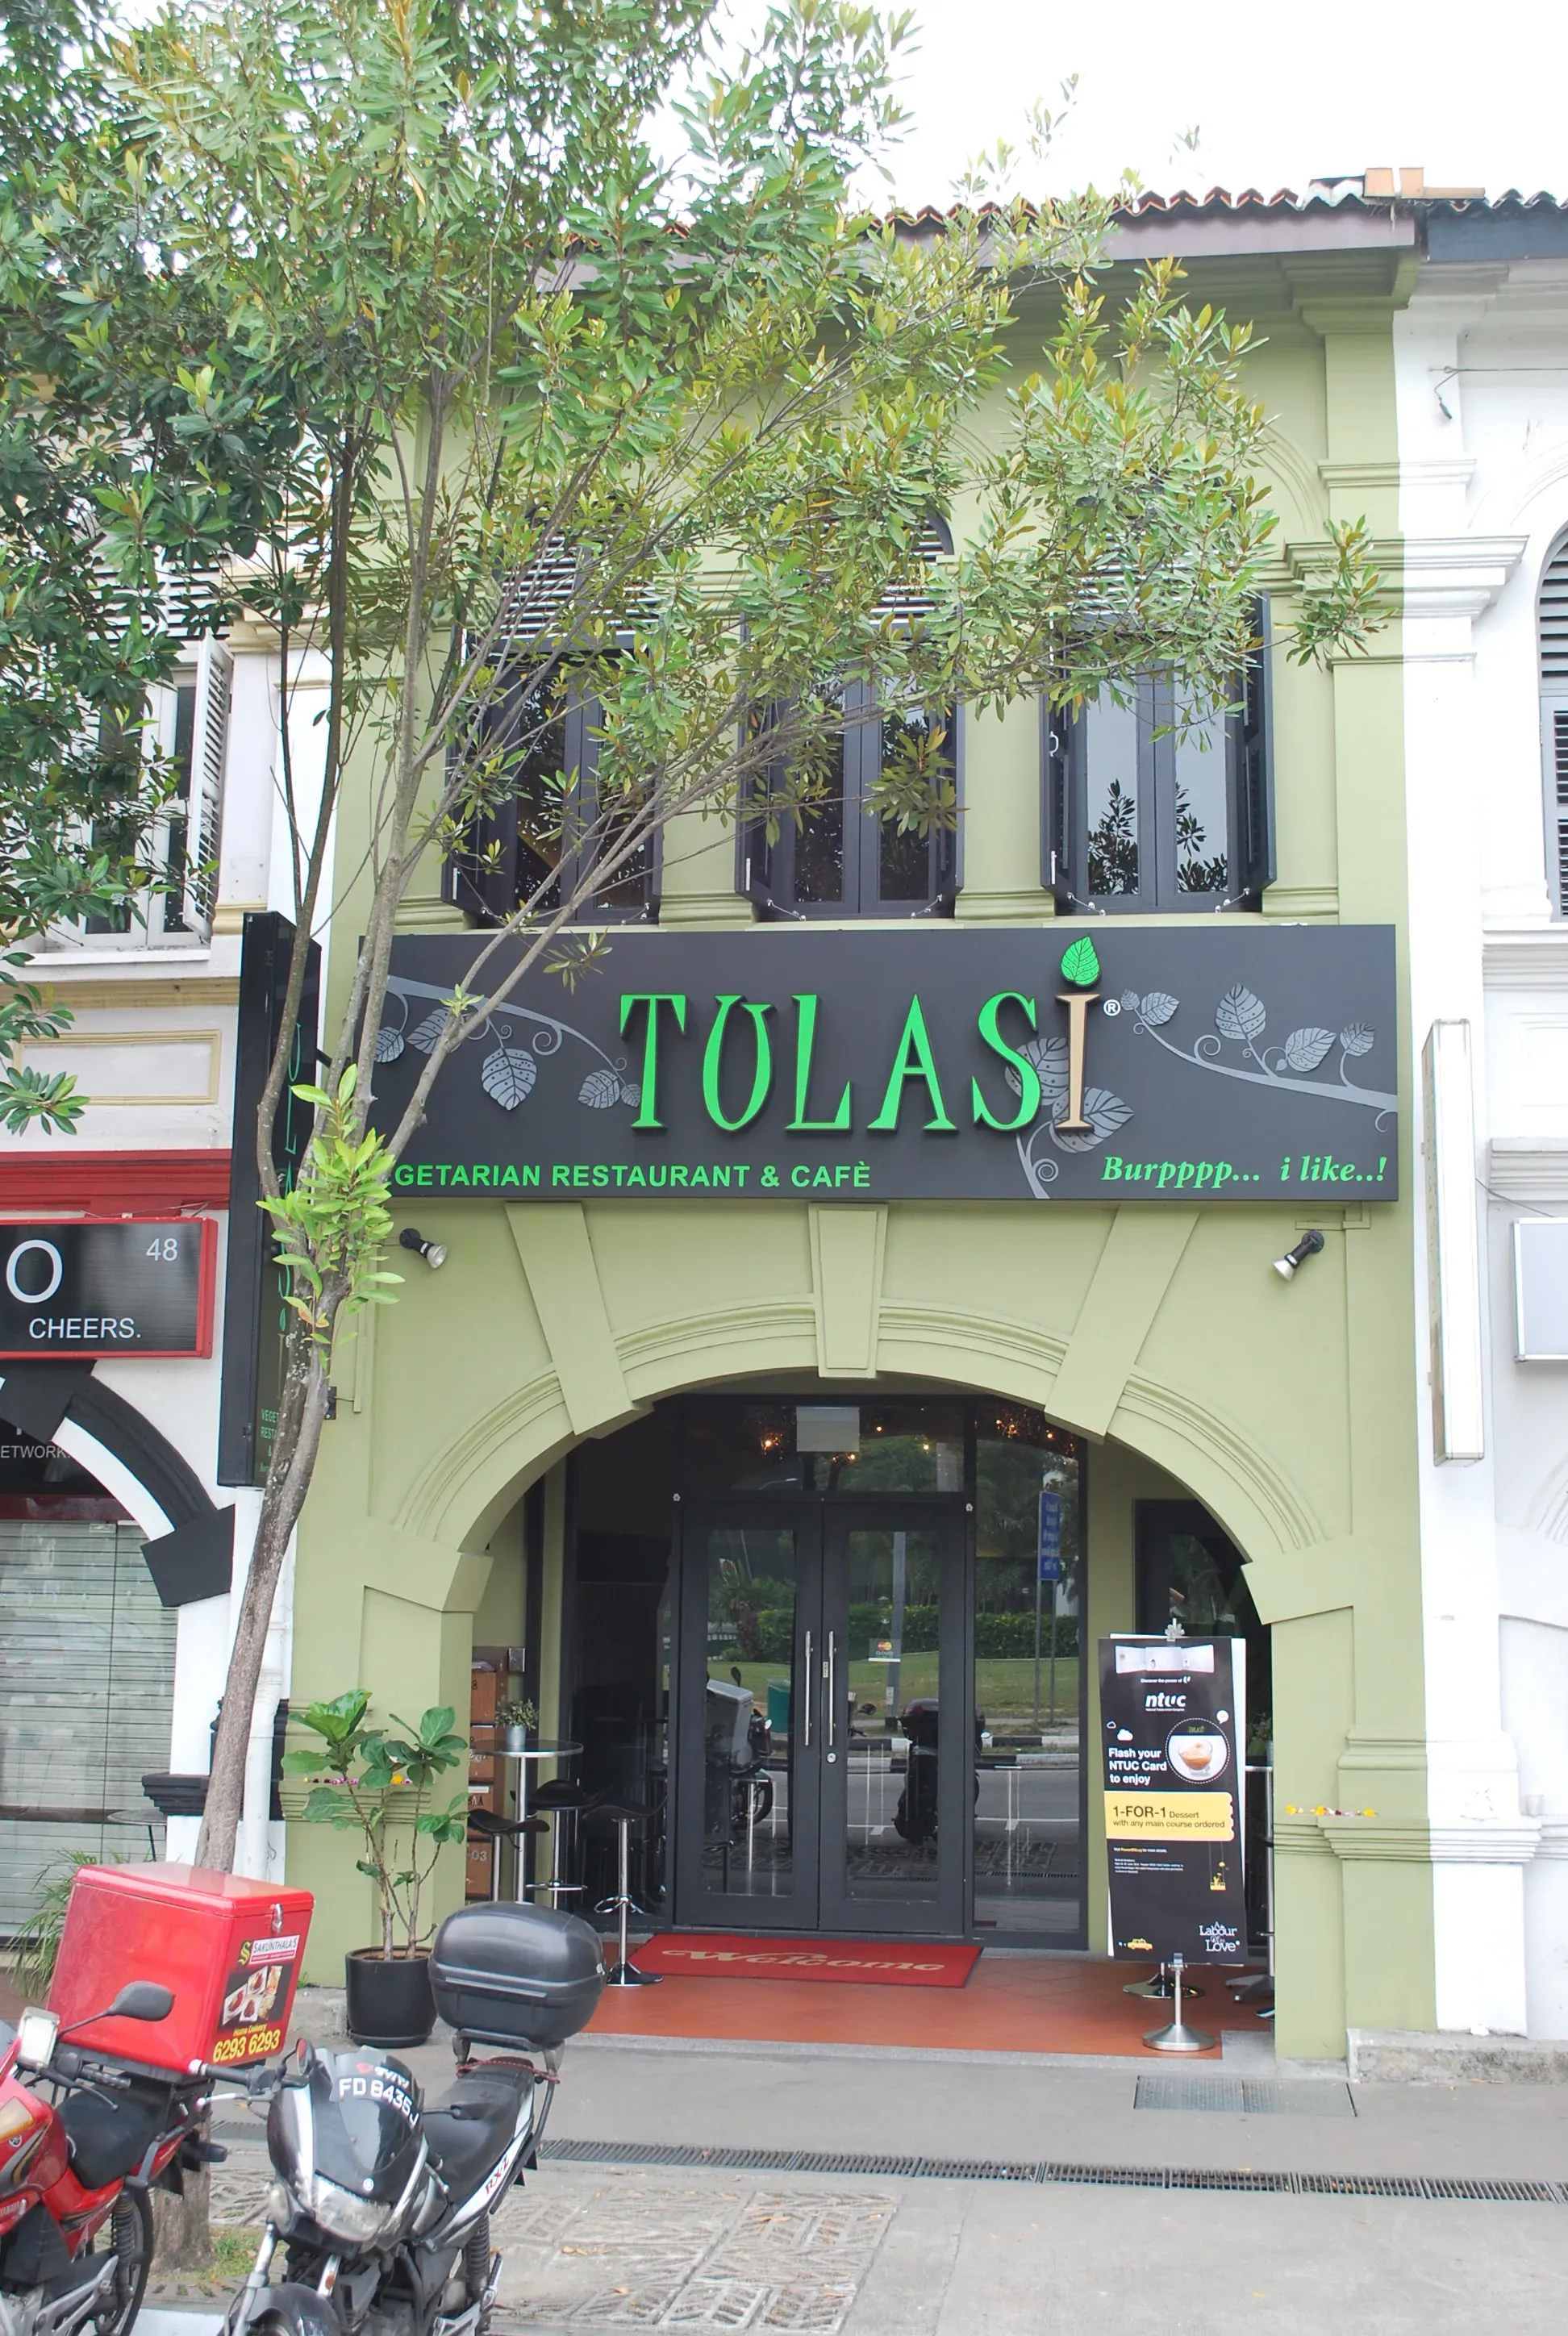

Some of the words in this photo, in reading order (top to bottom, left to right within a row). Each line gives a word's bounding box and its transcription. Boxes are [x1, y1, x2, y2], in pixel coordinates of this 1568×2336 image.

[619, 991, 1100, 1132] TULASI
[394, 1164, 540, 1187] GETARIAN
[553, 1165, 751, 1187] RESTAURANT
[761, 1166, 780, 1187] &
[1101, 1156, 1260, 1189] Burpppp...
[1280, 1156, 1291, 1181] i
[1299, 1155, 1387, 1182] like..!
[146, 1237, 178, 1262] 48
[29, 1316, 141, 1339] CHEERS.
[0, 1445, 71, 1458] ETWORK.
[1145, 1692, 1186, 1708] ntuc
[1108, 1747, 1136, 1758] Flash
[1137, 1749, 1162, 1760] your
[1108, 1760, 1140, 1771] NTUC
[1141, 1760, 1167, 1771] Card
[1109, 1773, 1121, 1783] to
[1122, 1773, 1151, 1786] enjoy
[1113, 1805, 1166, 1818] 1-FOR-1
[1169, 1810, 1199, 1819] Dessert
[1130, 1821, 1144, 1829] any
[1194, 1821, 1225, 1829] ordered
[1199, 1925, 1237, 1936] Labour
[1205, 1939, 1236, 1952] Love
[661, 1949, 945, 1971] Welcome
[213, 2036, 247, 2063] 6293
[248, 2029, 281, 2055] 6293
[339, 2077, 367, 2097] FD
